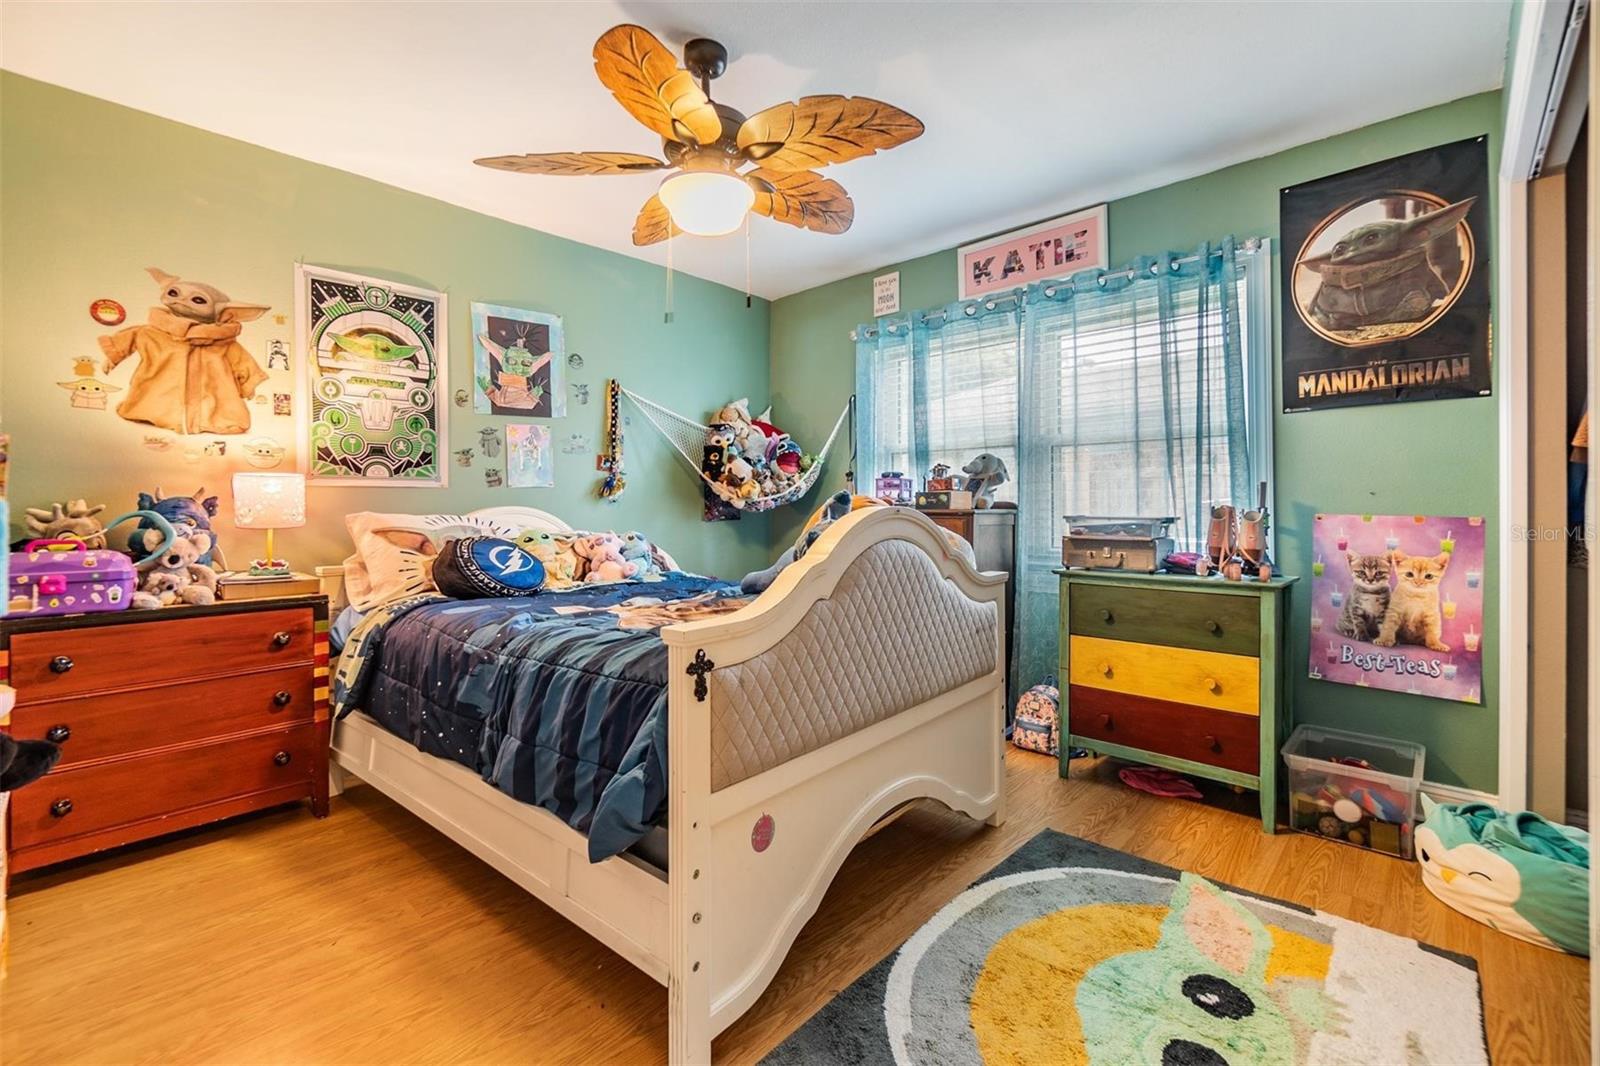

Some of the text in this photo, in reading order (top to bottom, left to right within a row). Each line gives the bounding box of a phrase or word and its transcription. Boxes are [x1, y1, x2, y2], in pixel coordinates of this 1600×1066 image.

[973, 230, 1088, 285] KATIE
[878, 293, 895, 305] MOON
[1298, 356, 1470, 398] MANDALORIAN
[469, 565, 501, 592] LEAGUE
[1341, 645, 1441, 678] Best-Teas
